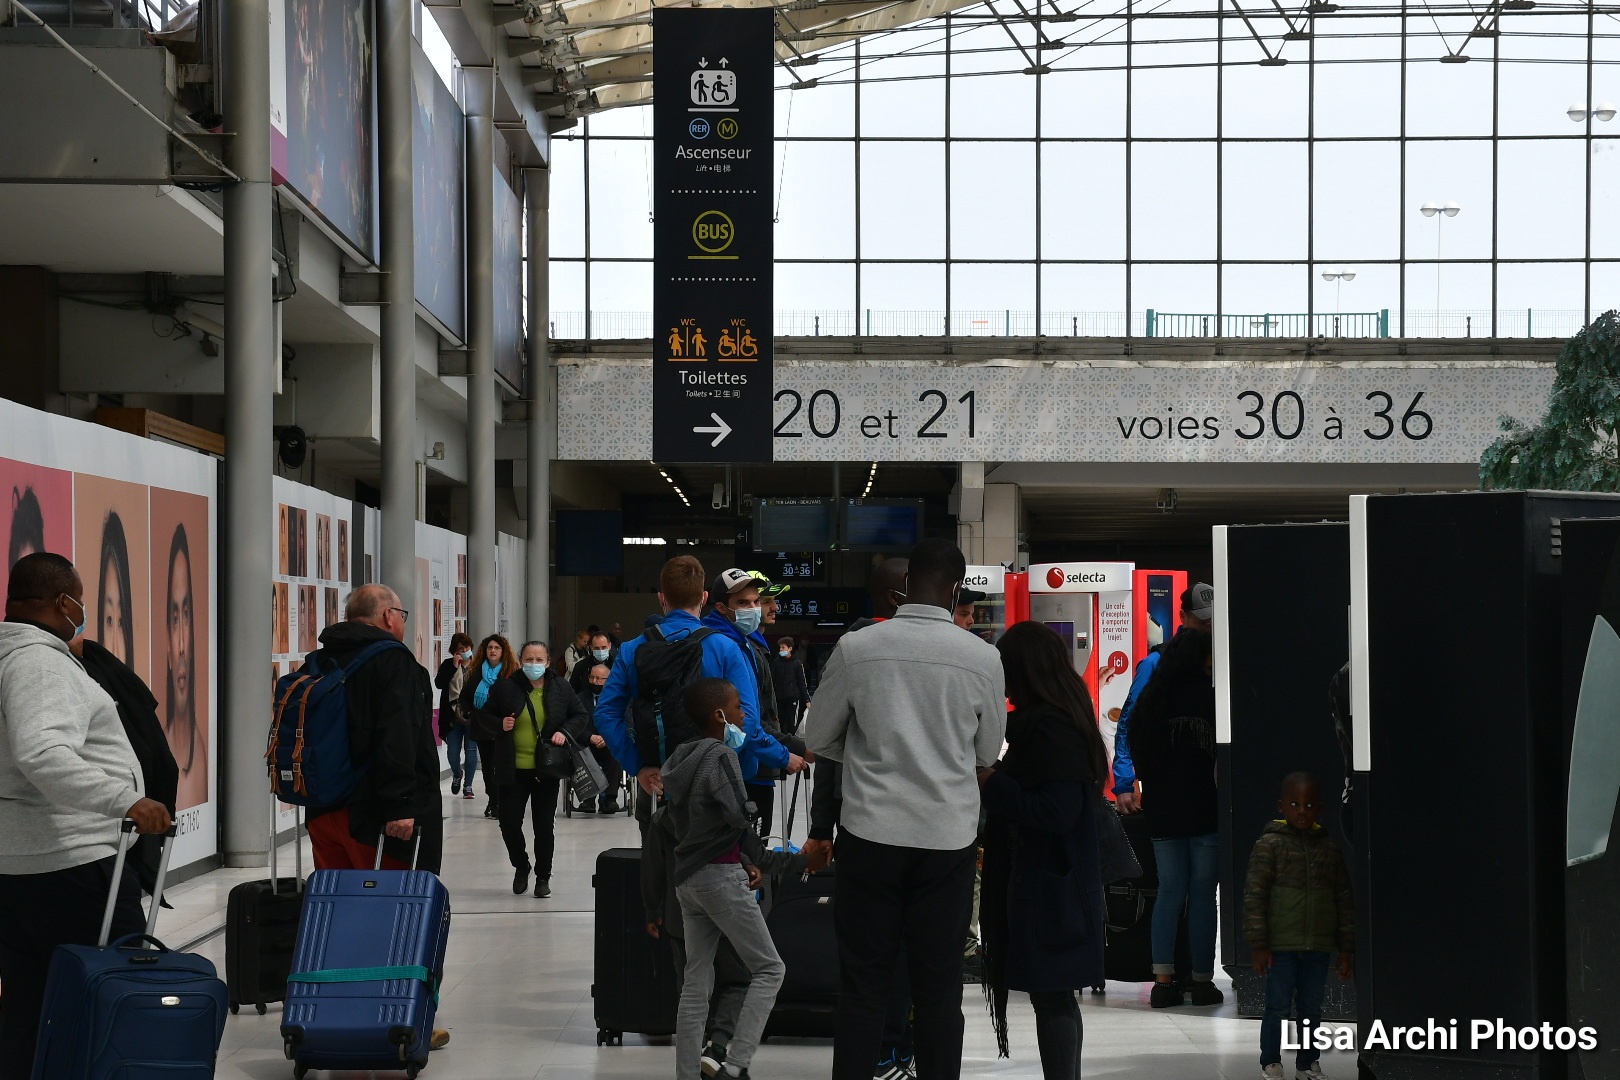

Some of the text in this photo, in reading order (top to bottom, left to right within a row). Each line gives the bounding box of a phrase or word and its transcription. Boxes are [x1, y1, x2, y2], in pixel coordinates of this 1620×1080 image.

[691, 124, 707, 133] RER
[721, 123, 734, 135] M
[675, 145, 751, 159] Ascenseur
[695, 164, 707, 172] Lift
[698, 223, 729, 240] BUS
[680, 318, 696, 326] WC
[730, 318, 746, 326] WC
[678, 370, 748, 385] Toilettes
[685, 389, 708, 398] Toilets
[713, 389, 741, 399] 卫生间
[773, 389, 975, 439] 20 et 21
[1116, 390, 1434, 441] voies 30 à 36
[783, 566, 794, 575] 30
[800, 566, 811, 575] 36
[964, 574, 988, 586] ecta
[1066, 571, 1106, 583] selecta
[789, 603, 803, 614] 36
[1105, 602, 1125, 610] Un café
[1106, 619, 1130, 627] emporter
[1102, 627, 1114, 635] pour
[1113, 656, 1123, 668] ici
